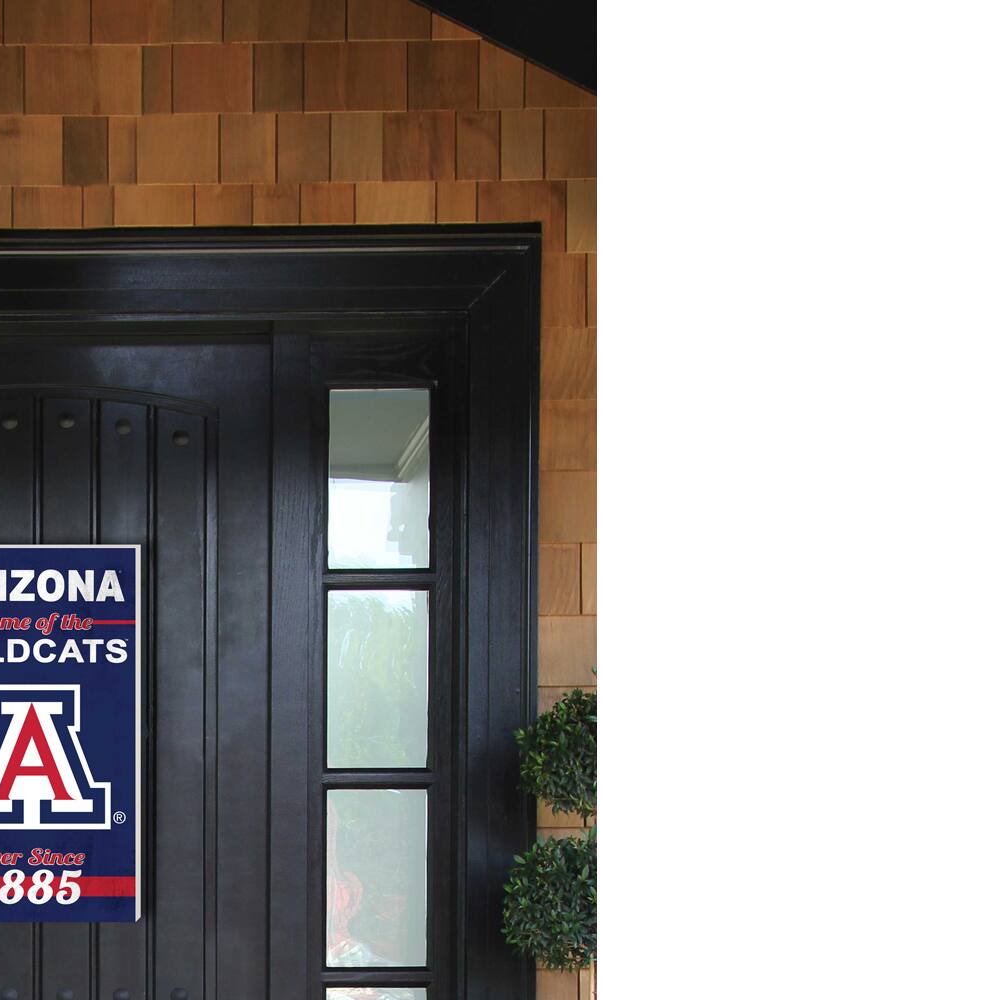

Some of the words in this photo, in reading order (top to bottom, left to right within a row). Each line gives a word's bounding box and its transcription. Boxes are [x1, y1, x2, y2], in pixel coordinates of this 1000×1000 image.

[35, 612, 59, 635] of
[61, 613, 94, 631] the
[27, 847, 86, 866] Since
